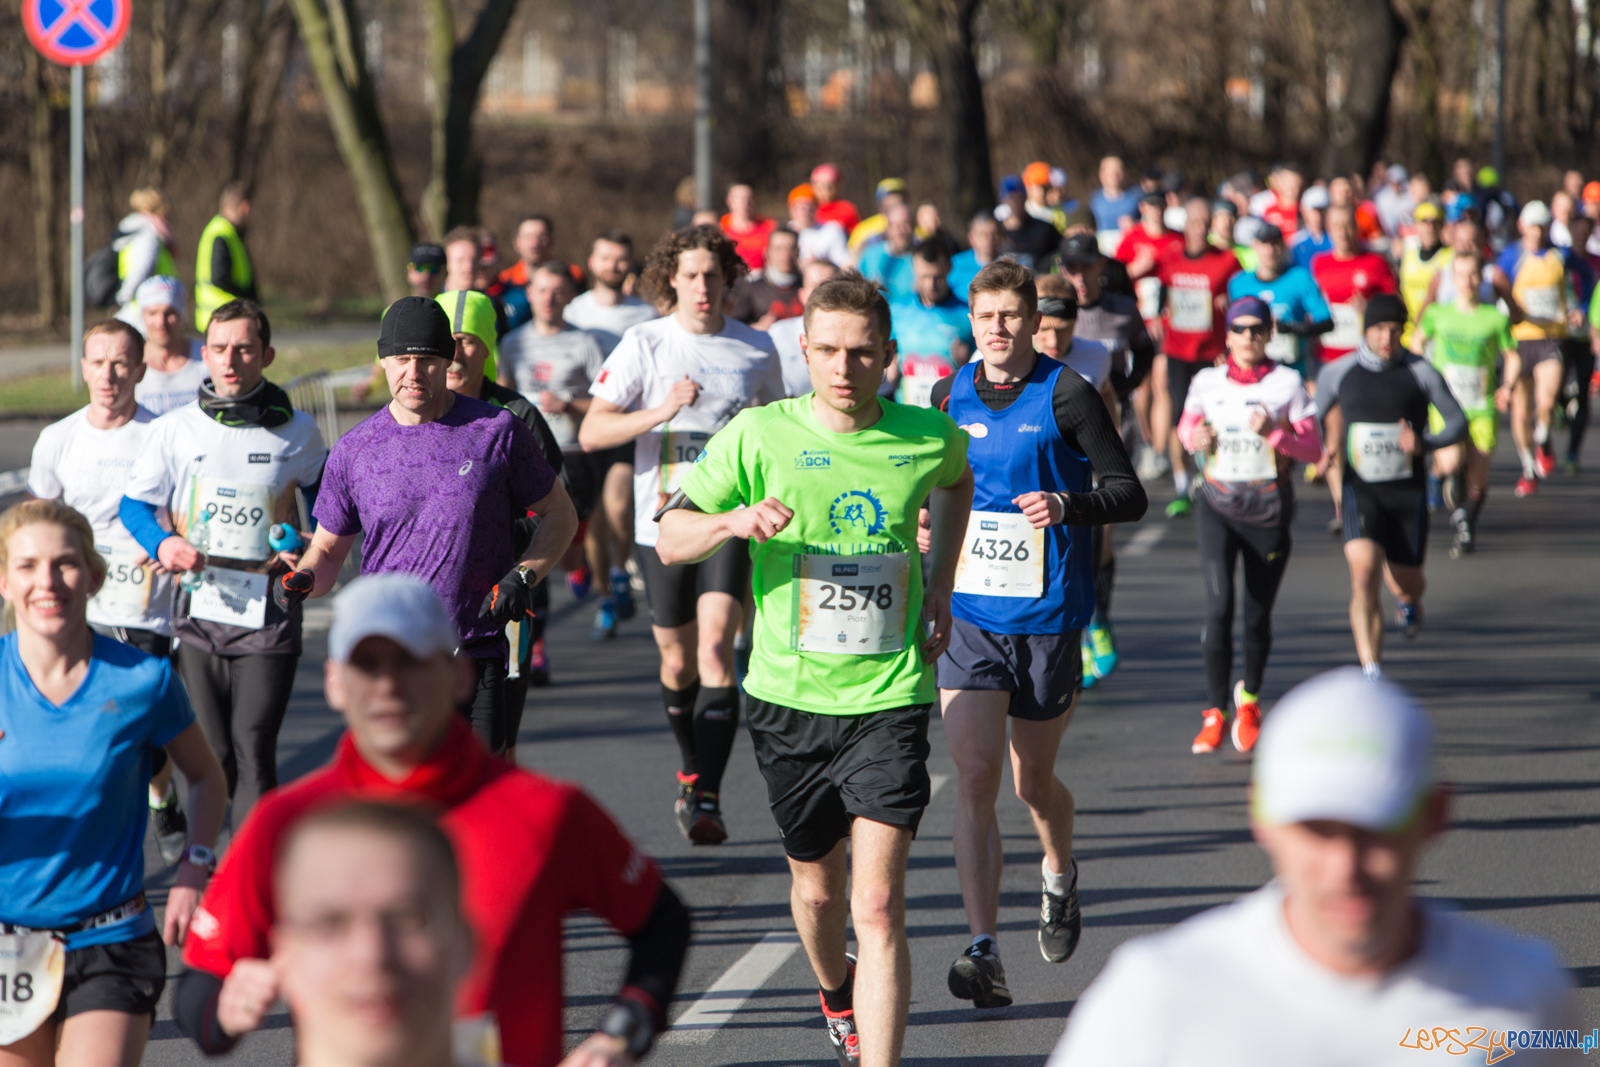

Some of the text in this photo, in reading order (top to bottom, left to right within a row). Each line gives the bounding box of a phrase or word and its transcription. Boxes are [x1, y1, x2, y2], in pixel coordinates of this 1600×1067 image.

[206, 502, 263, 527] 9569
[971, 538, 1029, 562] 4326
[988, 563, 1009, 572] Maciej
[819, 584, 893, 611] 2578
[847, 615, 867, 623] Piotr
